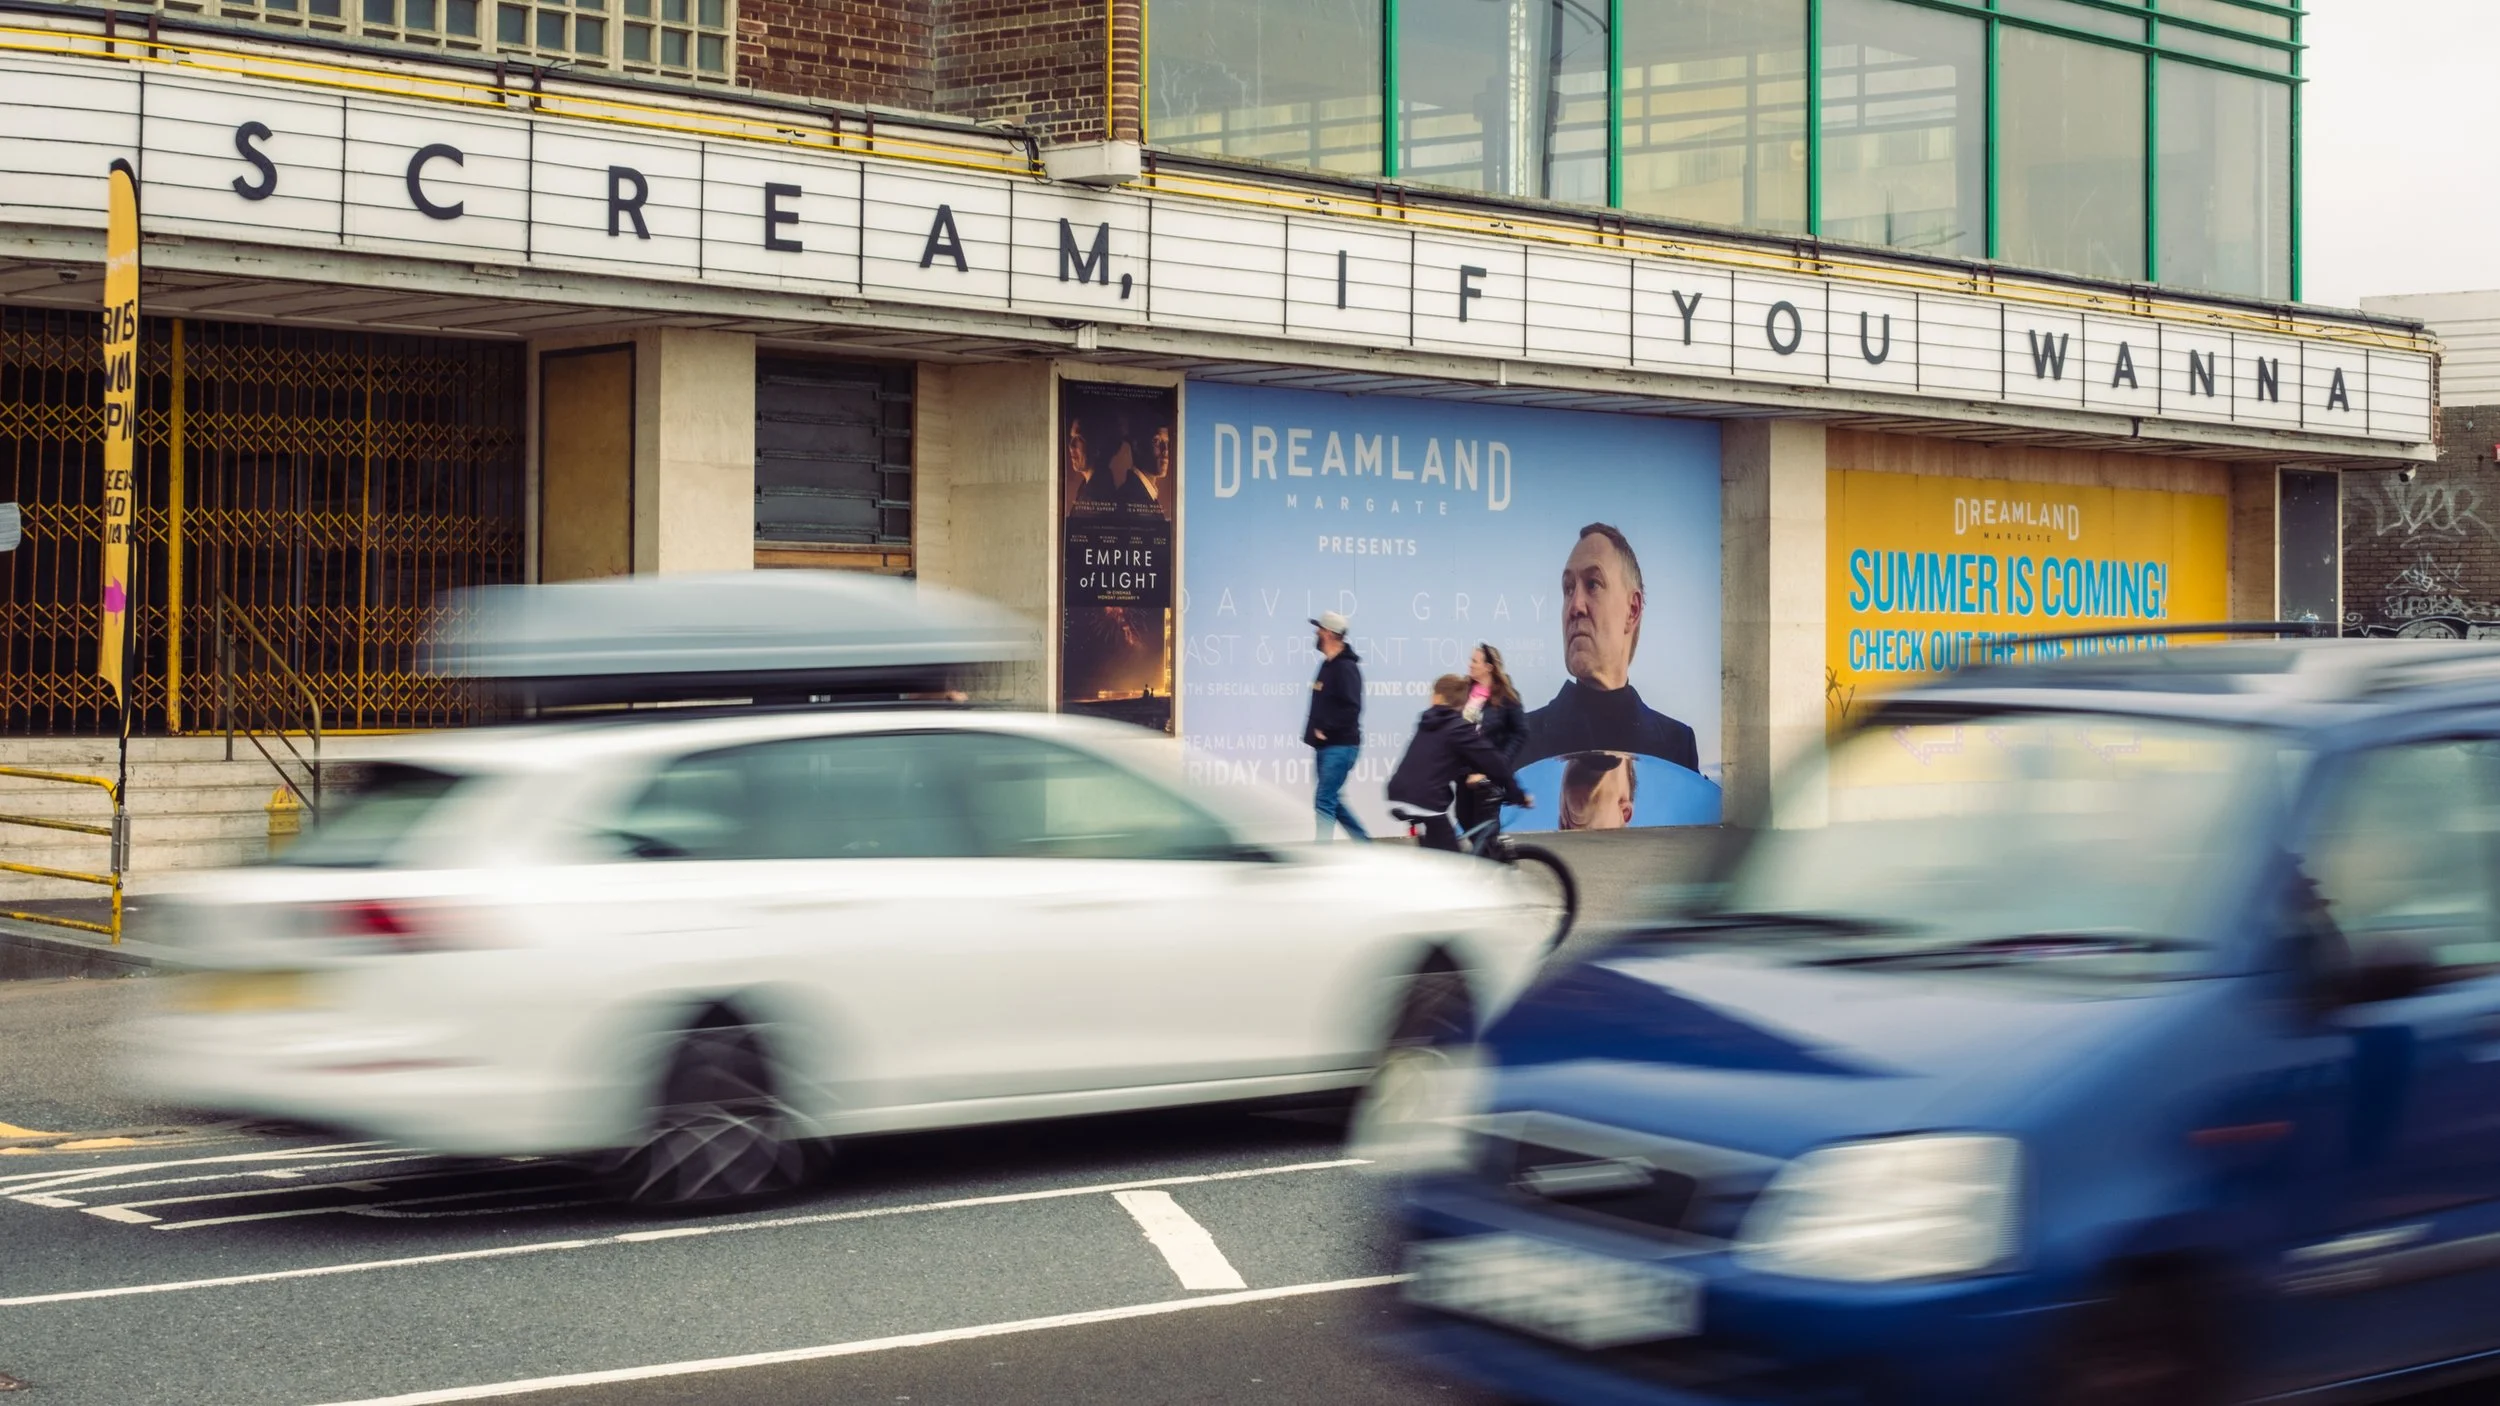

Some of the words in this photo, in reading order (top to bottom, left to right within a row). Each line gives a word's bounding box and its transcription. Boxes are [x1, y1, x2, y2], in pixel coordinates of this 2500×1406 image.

[231, 120, 1135, 301] SCREAM,
[1336, 248, 1488, 324] IF
[1671, 289, 1890, 366] YOU
[2029, 329, 2350, 412] WANNA
[1213, 422, 1513, 513] DREAMLAND
[1286, 493, 1449, 516] MARGATE
[1954, 497, 2080, 541] DREAMLAND
[1318, 534, 1418, 557] PRESENTS
[1983, 531, 2053, 543] MARGATE
[1085, 548, 1153, 567] EMPIRE
[1080, 572, 1096, 588] of
[1101, 571, 1158, 590] LIGHT
[1849, 548, 2001, 615] SUMMER
[2006, 554, 2036, 617] IS
[2040, 556, 2169, 620] COMING!
[1412, 591, 1548, 621] GRAY
[1184, 633, 1241, 667] AST
[1256, 634, 1275, 667] &
[1286, 636, 1409, 668] PRENT
[1848, 628, 1928, 673] CHECK
[1929, 629, 1975, 673] OUT
[1207, 682, 1258, 697] SPECIAL
[1262, 682, 1300, 697] GUEST
[1184, 733, 1267, 751] REAMLAND
[1184, 758, 1262, 787] RIDAY
[1272, 758, 1315, 785] 10T
[1355, 756, 1398, 783] ULY
